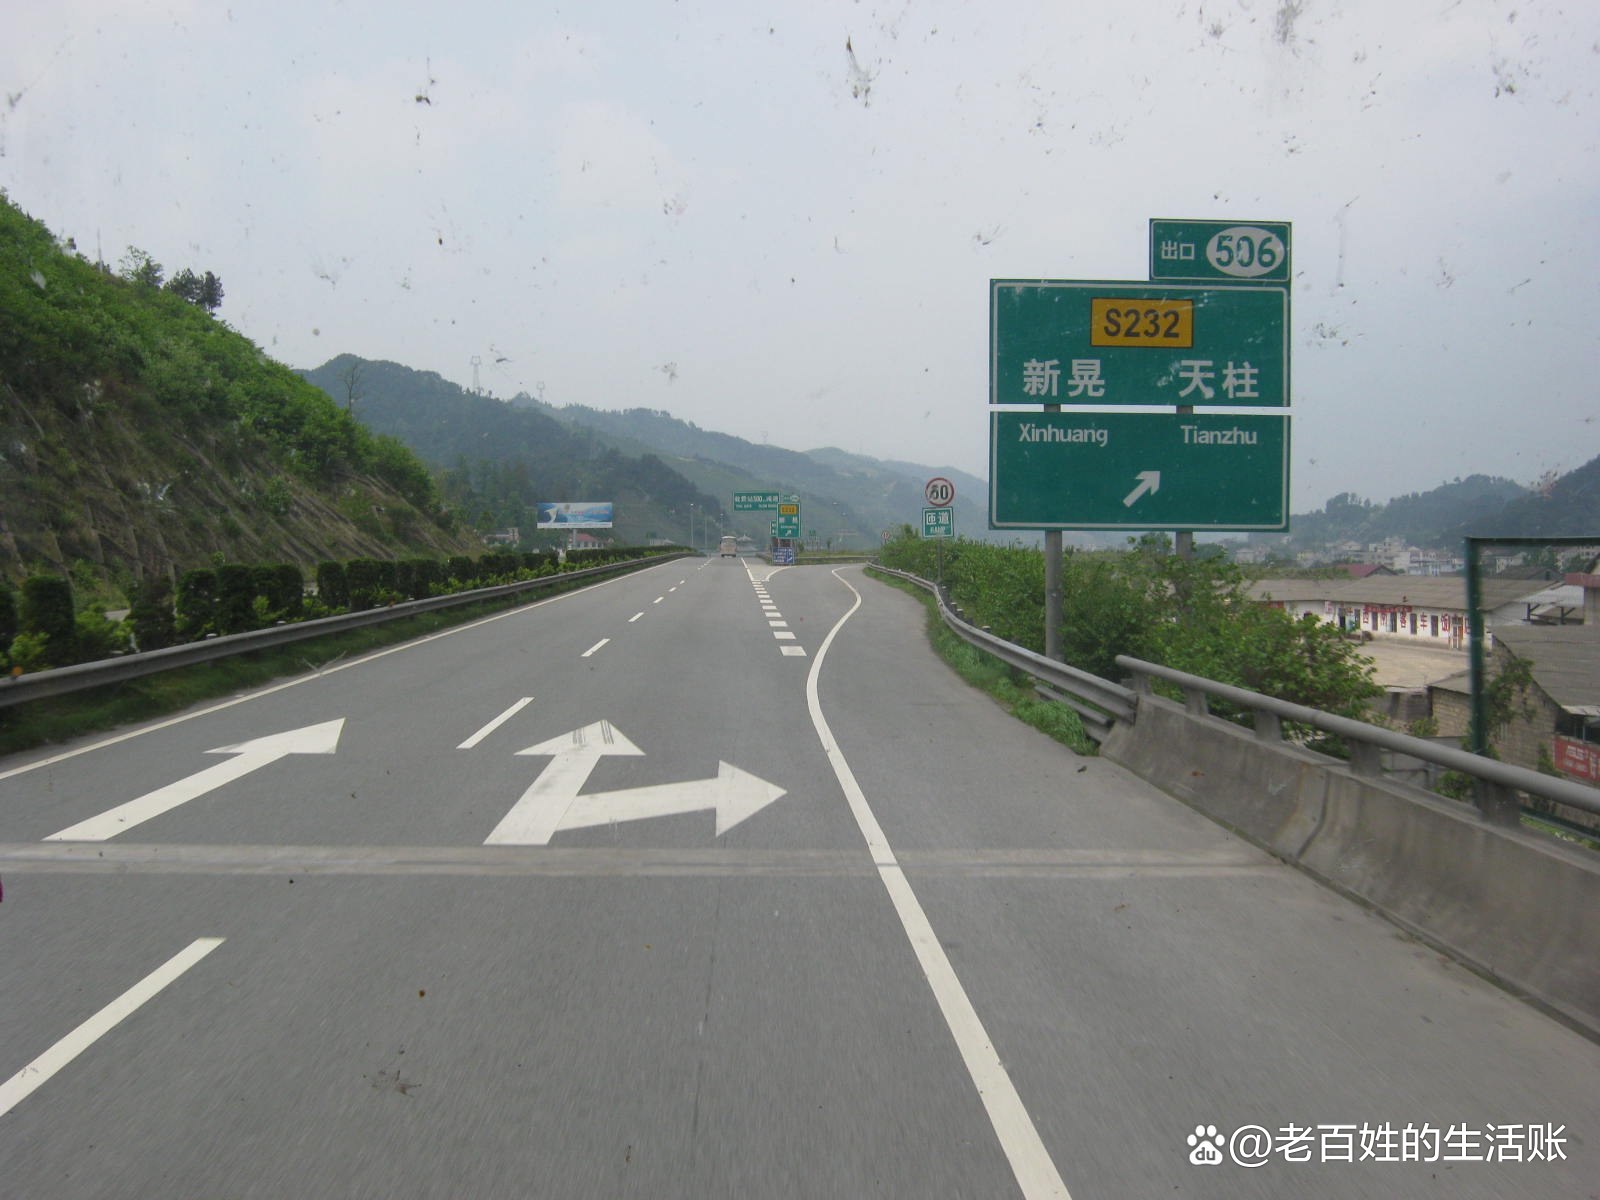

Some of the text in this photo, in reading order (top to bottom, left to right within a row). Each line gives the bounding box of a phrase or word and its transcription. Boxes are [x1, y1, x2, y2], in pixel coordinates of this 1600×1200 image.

[1160, 234, 1277, 267] 出口 506
[1103, 308, 1180, 338] S232
[1022, 358, 1261, 400] 新晃 天柱
[1018, 423, 1257, 448] Xinhuang Tianzhu
[926, 511, 950, 525] 匝道
